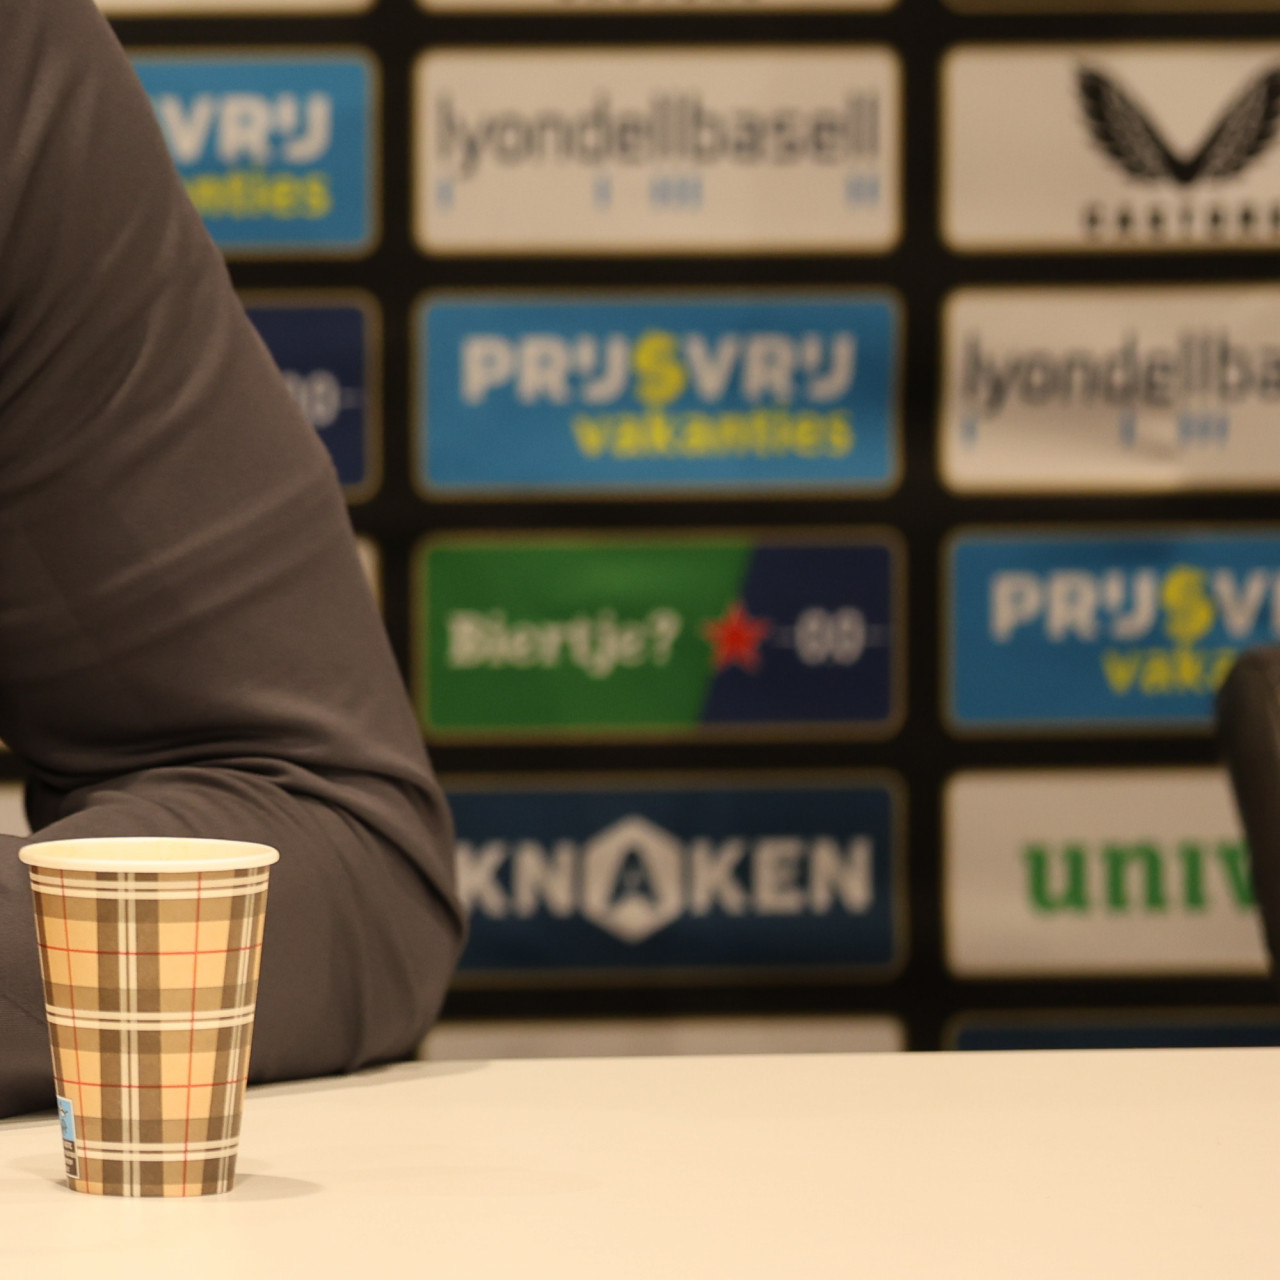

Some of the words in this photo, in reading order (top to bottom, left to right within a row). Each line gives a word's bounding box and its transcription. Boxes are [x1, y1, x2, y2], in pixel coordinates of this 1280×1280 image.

[437, 91, 881, 180] lyondellbasell
[962, 328, 1280, 420] lyondellba
[570, 409, 854, 461] vakanties
[989, 568, 1280, 643] PRIJSV
[447, 610, 683, 678] Biertje?
